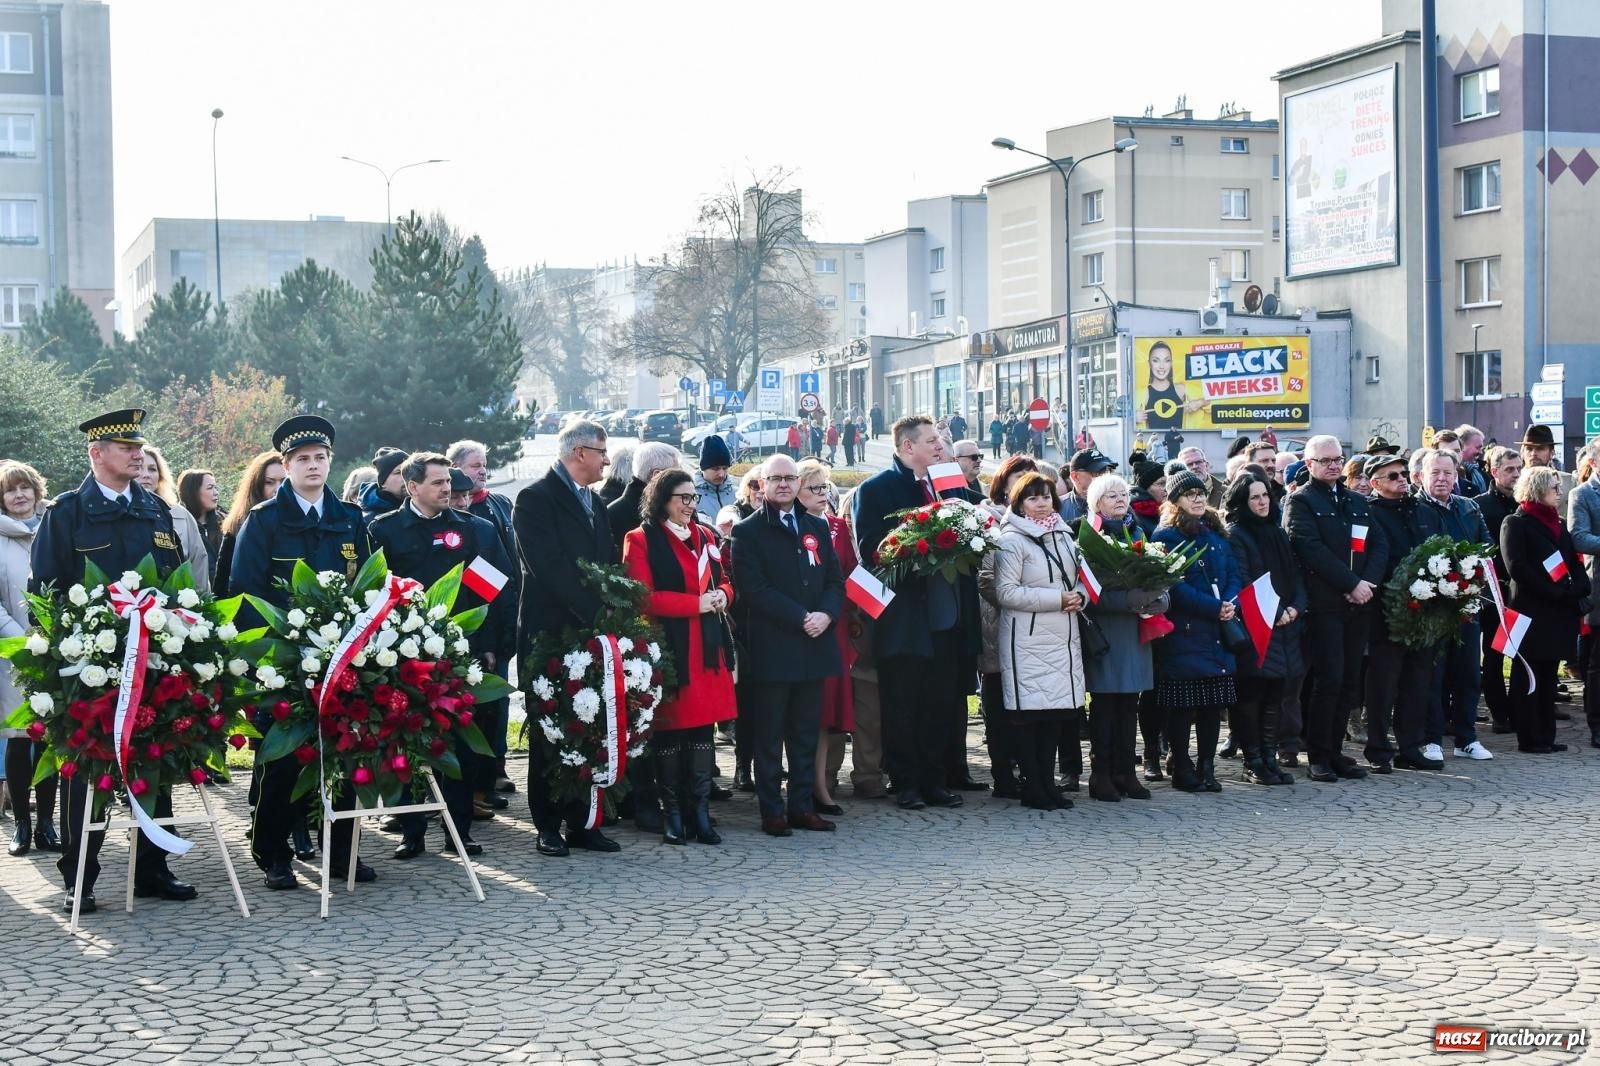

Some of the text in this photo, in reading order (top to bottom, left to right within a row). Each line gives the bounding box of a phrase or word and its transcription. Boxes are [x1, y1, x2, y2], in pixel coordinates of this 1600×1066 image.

[1014, 327, 1057, 349] GRAMATURA
[1190, 348, 1284, 378] BLACK
[713, 381, 723, 394] P
[766, 372, 777, 387] P
[1205, 377, 1279, 397] WEEKS!
[1217, 407, 1290, 421] mediaexpert
